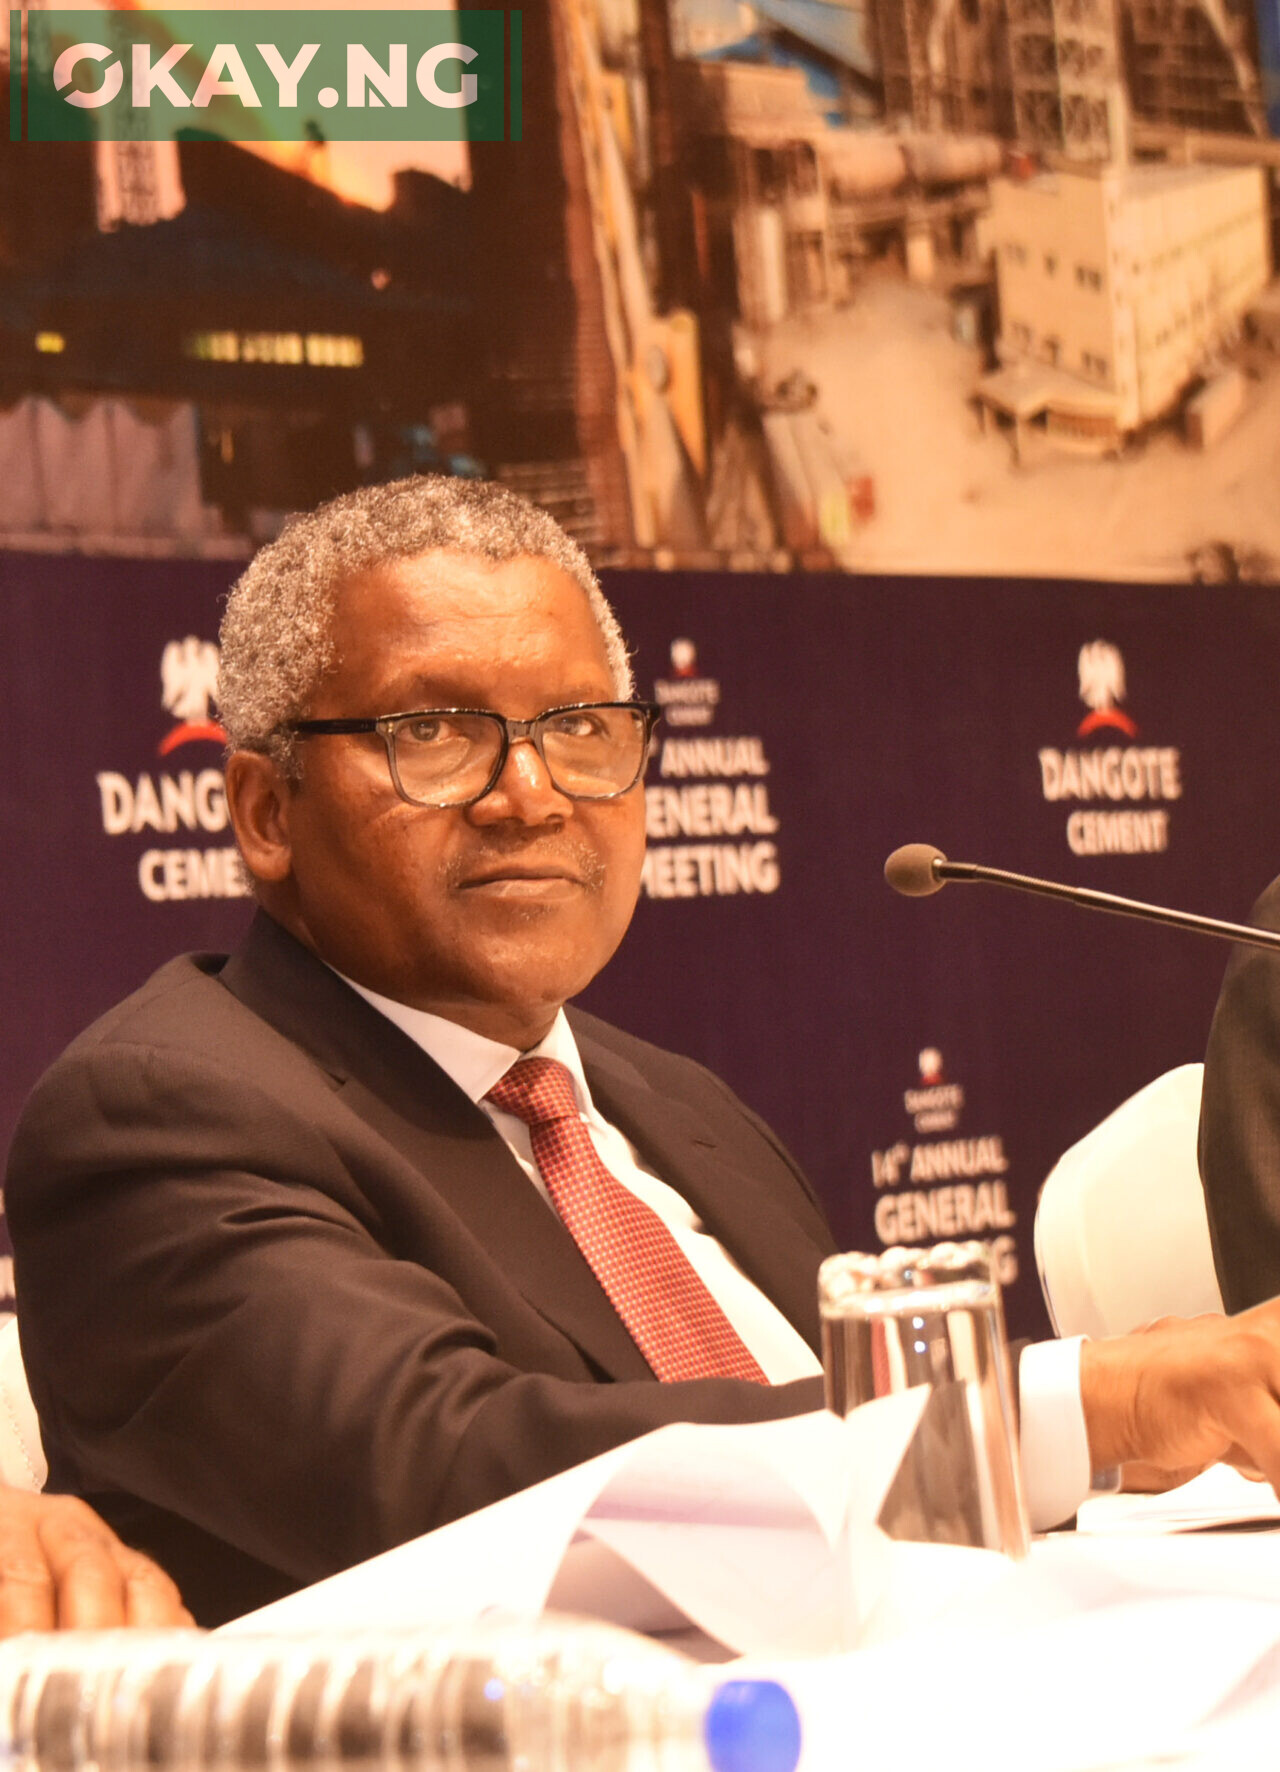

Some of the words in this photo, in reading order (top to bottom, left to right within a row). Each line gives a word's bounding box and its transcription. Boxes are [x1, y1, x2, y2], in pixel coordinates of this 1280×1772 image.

[659, 735, 769, 778] ANNUAL
[1038, 746, 1181, 801] DANGOTE
[97, 767, 234, 835] DANG
[645, 782, 780, 838] ENERAL
[1066, 809, 1169, 856] CEMENT
[138, 848, 252, 901] CEME
[910, 1134, 1009, 1183] ANNUAL
[874, 1178, 1017, 1246] GENERAL
